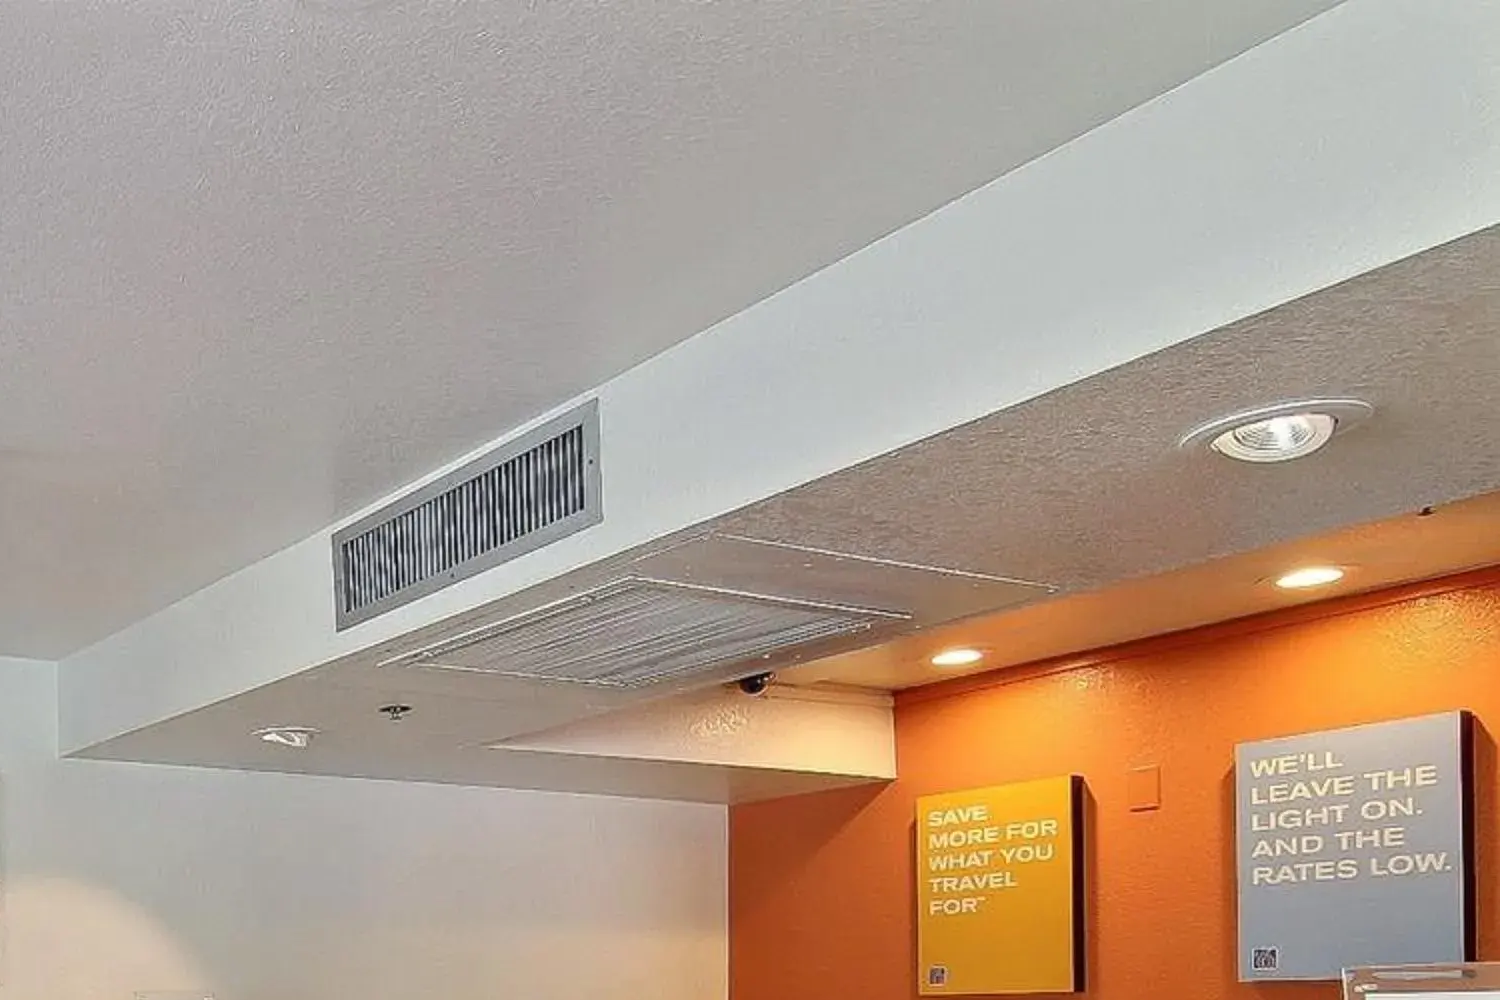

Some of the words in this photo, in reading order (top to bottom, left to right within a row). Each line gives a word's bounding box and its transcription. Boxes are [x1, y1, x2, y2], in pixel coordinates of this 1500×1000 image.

[1250, 751, 1344, 777] WE'LL
[1251, 776, 1355, 805] LEAVE
[1364, 765, 1438, 791] THE
[928, 805, 988, 828] SAVE
[1251, 804, 1350, 831] LIGHT
[1361, 797, 1423, 820] ON.
[928, 826, 1000, 849] MORE
[1006, 819, 1058, 841] FOR
[1252, 835, 1324, 858] AND
[1335, 827, 1405, 851] THE
[929, 850, 994, 871] WHAT
[1000, 843, 1054, 864] YOU
[1252, 859, 1359, 885] RATES
[1370, 852, 1453, 876] LOW.
[928, 871, 1018, 893] TRAVEL
